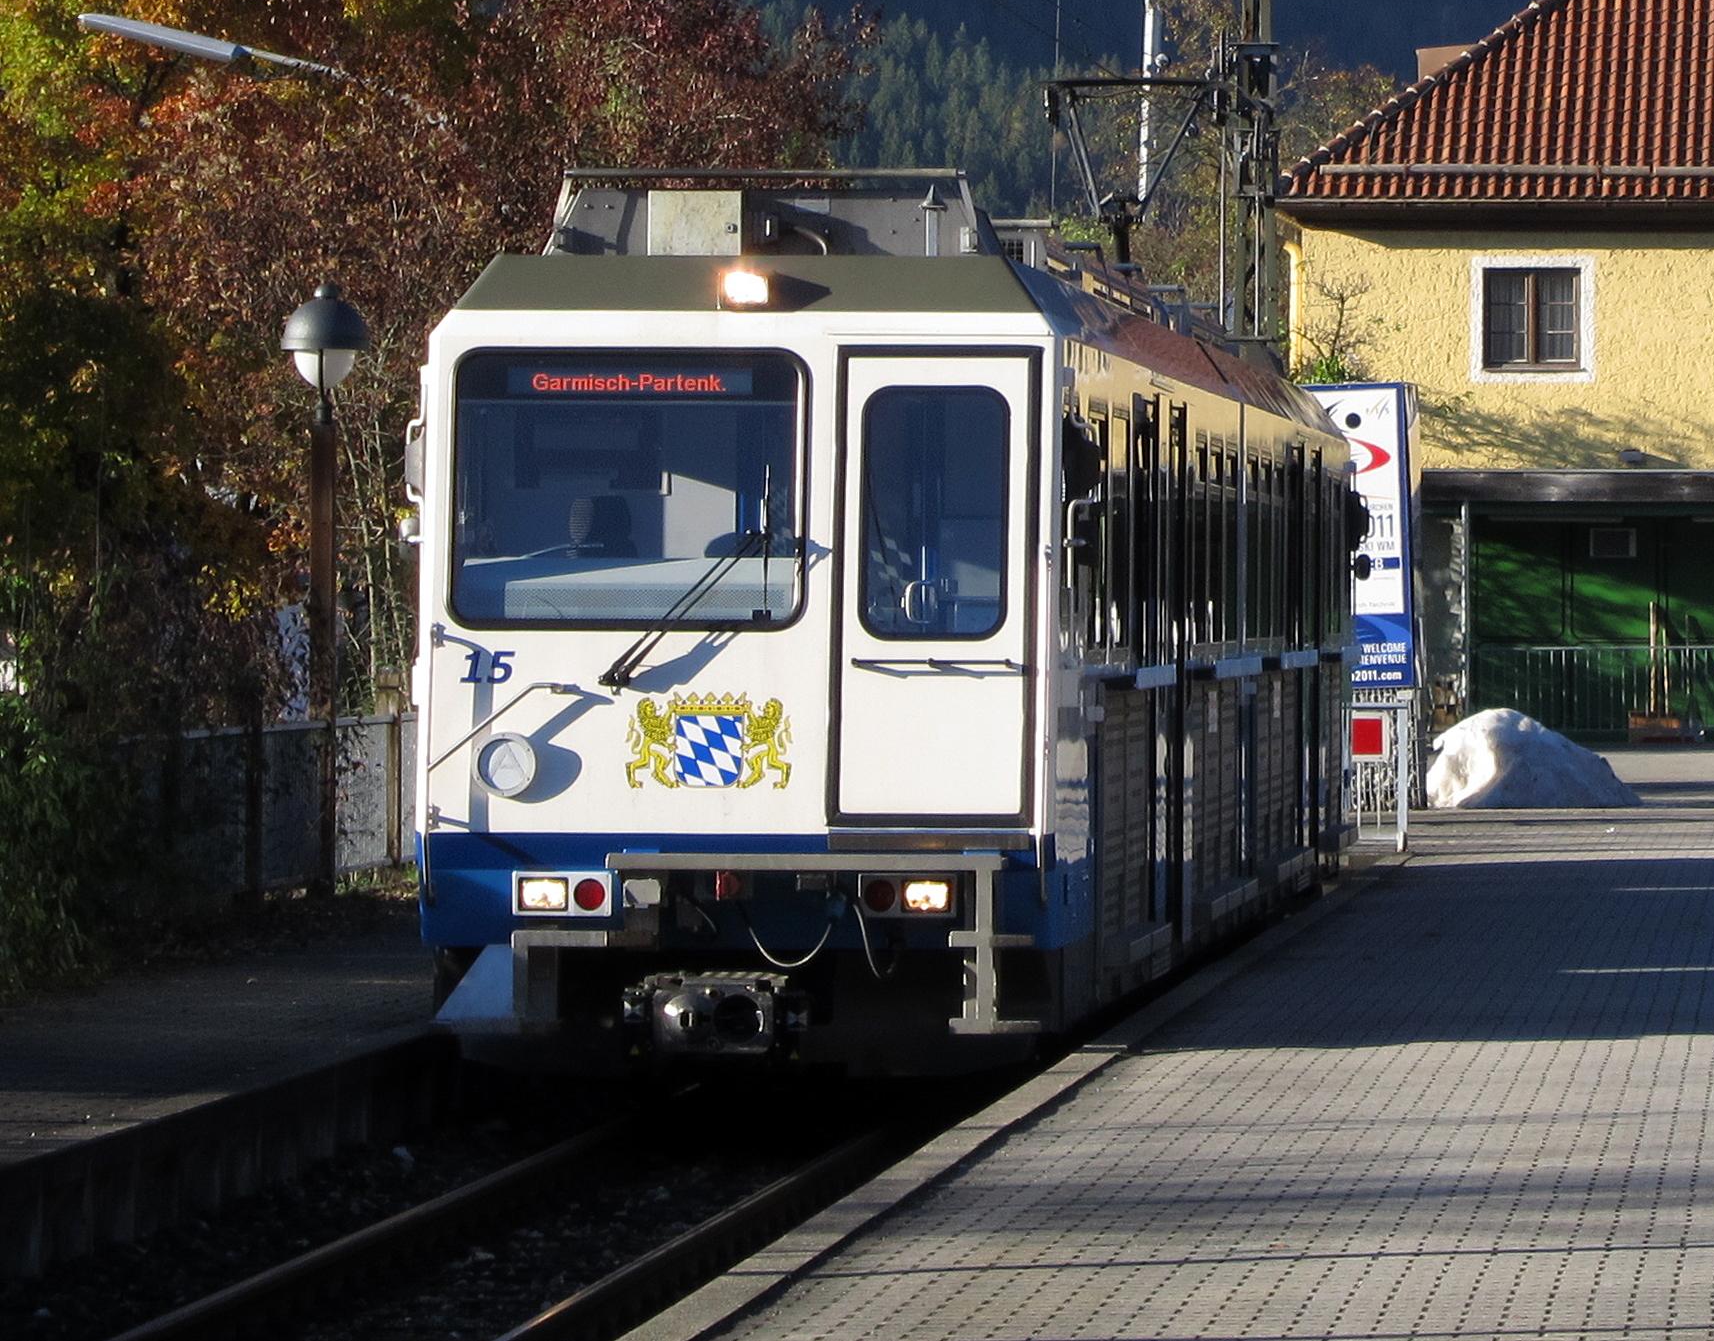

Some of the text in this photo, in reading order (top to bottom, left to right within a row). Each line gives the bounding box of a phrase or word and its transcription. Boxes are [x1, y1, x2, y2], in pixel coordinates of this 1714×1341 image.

[531, 372, 727, 394] Garmisch-Partenk.
[1367, 513, 1394, 538] 011
[1362, 642, 1407, 653] WELCOME
[459, 650, 516, 684] 15
[1360, 653, 1407, 665] IENVENUE
[1351, 669, 1403, 682] 2011.com
